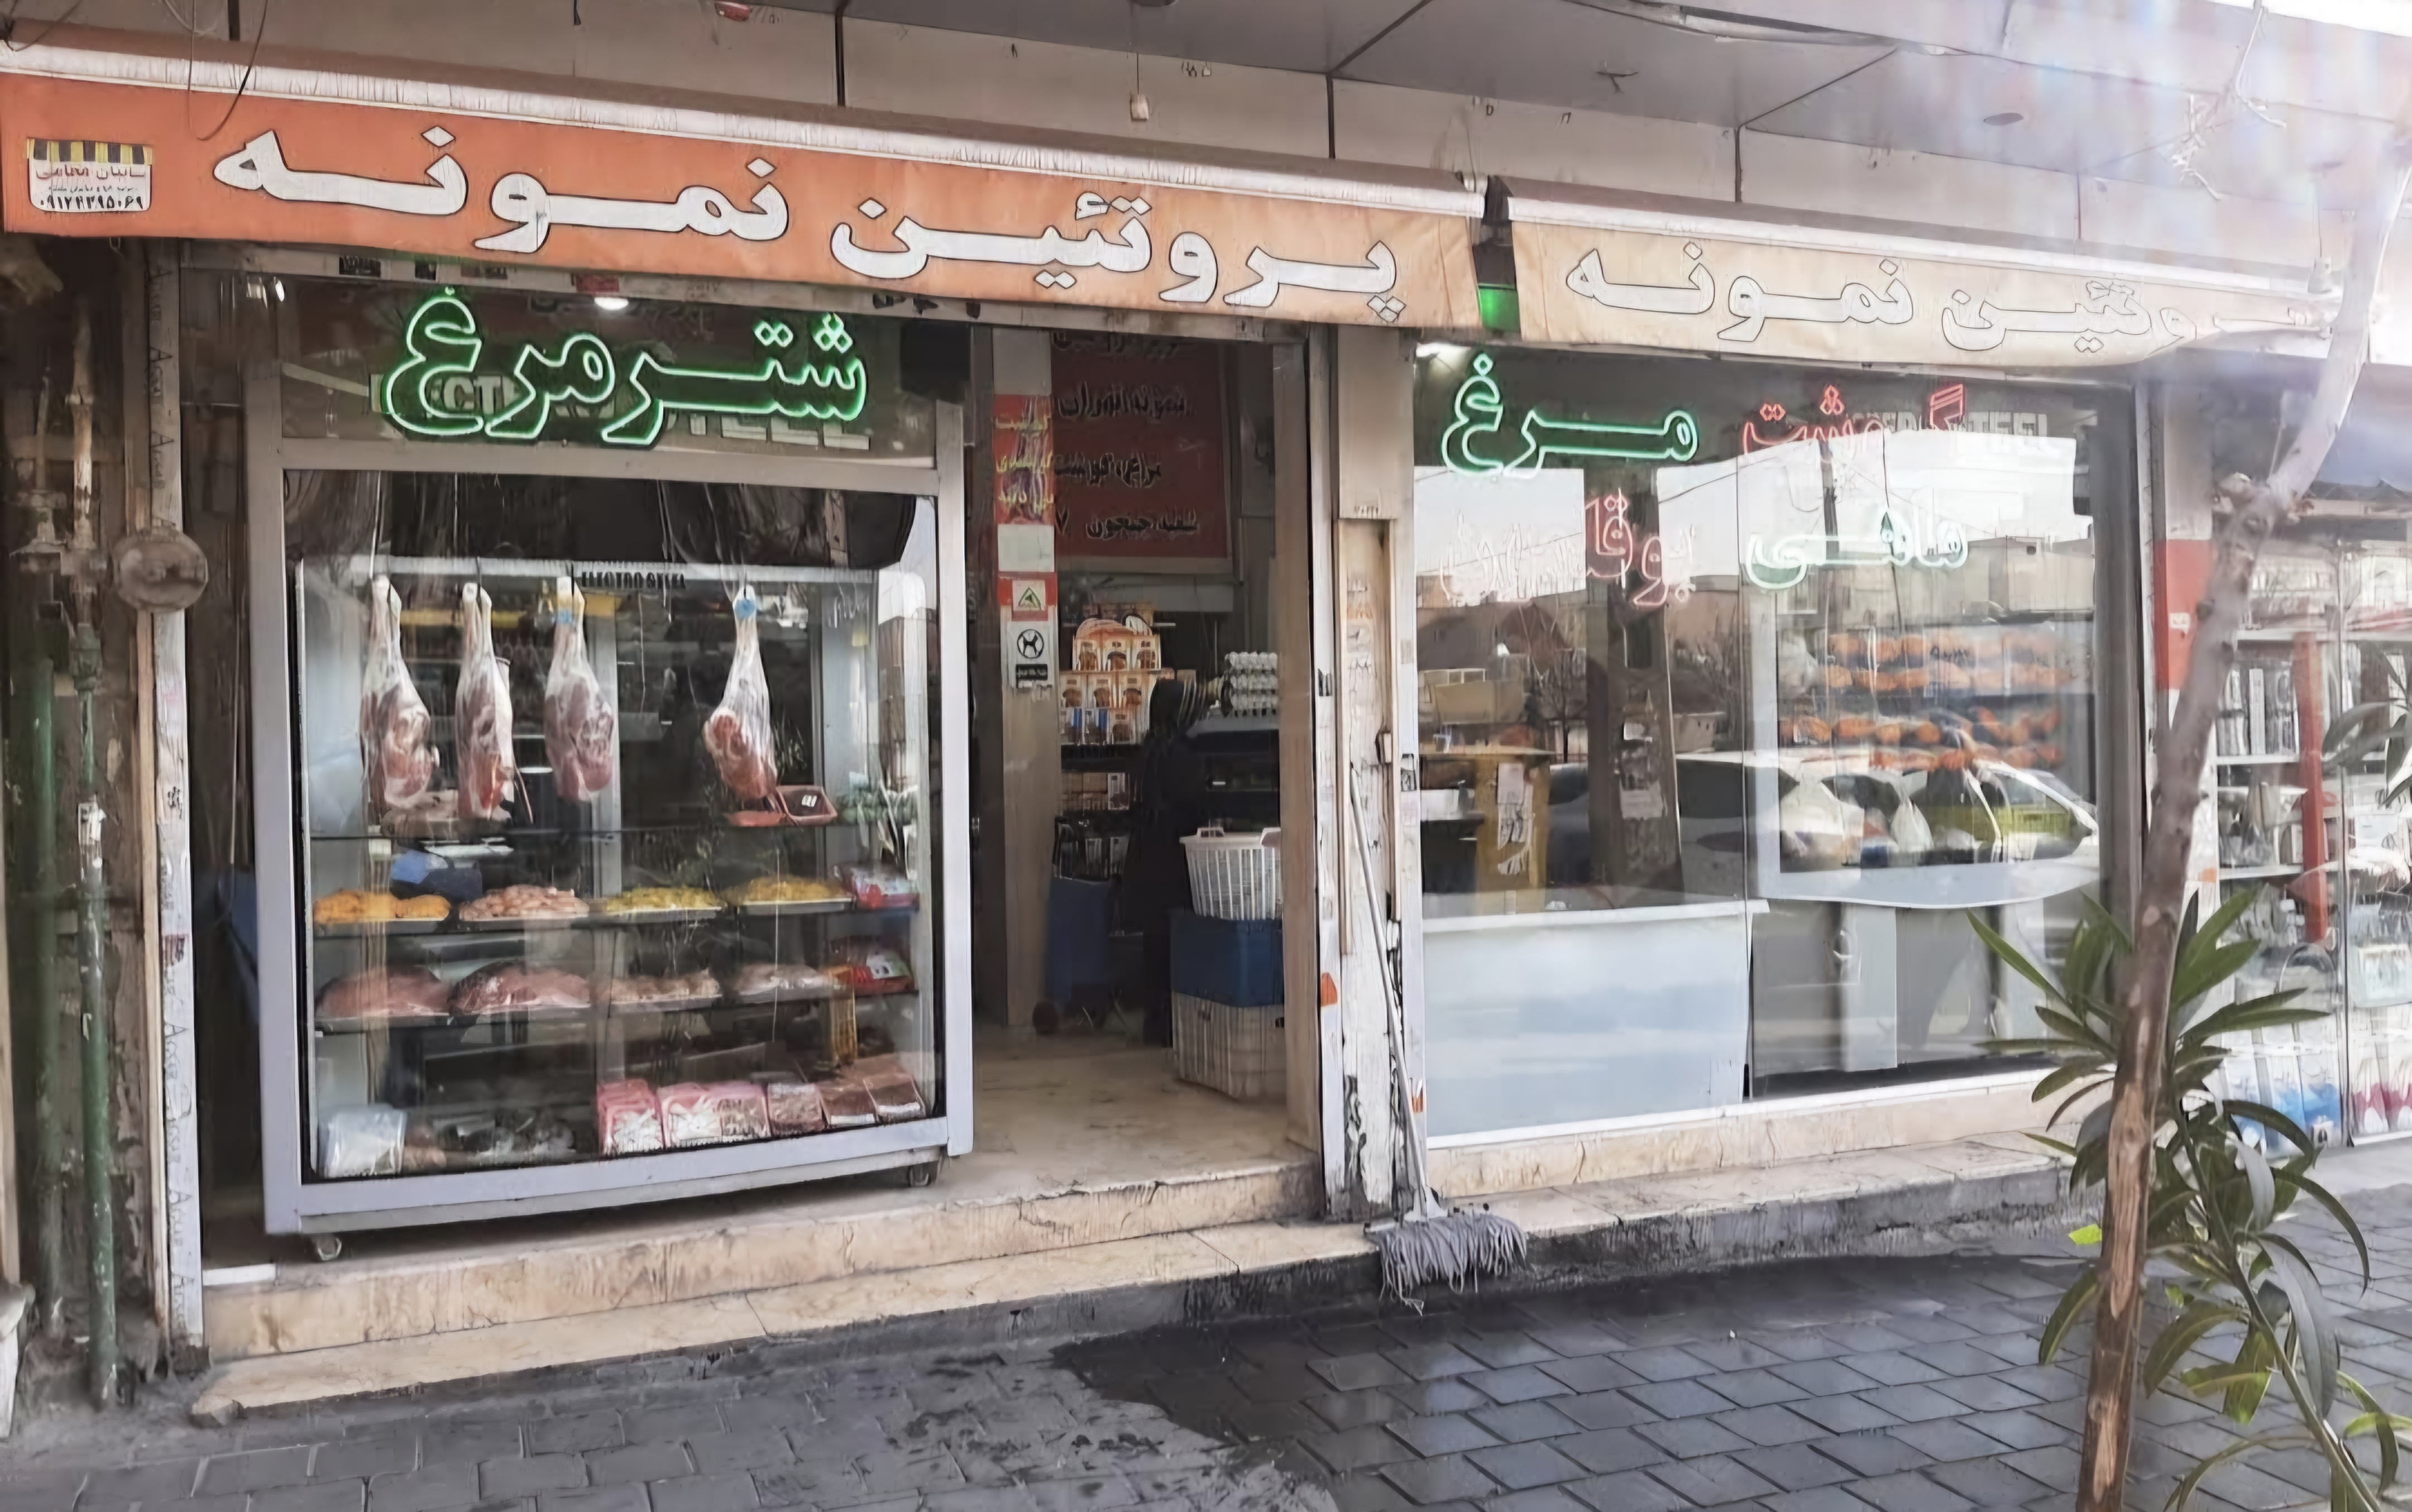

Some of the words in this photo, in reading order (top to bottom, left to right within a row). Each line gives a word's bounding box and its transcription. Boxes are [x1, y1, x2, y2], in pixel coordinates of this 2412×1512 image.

[212, 125, 790, 255] نمونه
[830, 191, 1407, 323] پروتئین
[1566, 241, 1914, 342] نمونه
[381, 285, 869, 444] شترمرغ
[1442, 353, 1698, 481] مرغ
